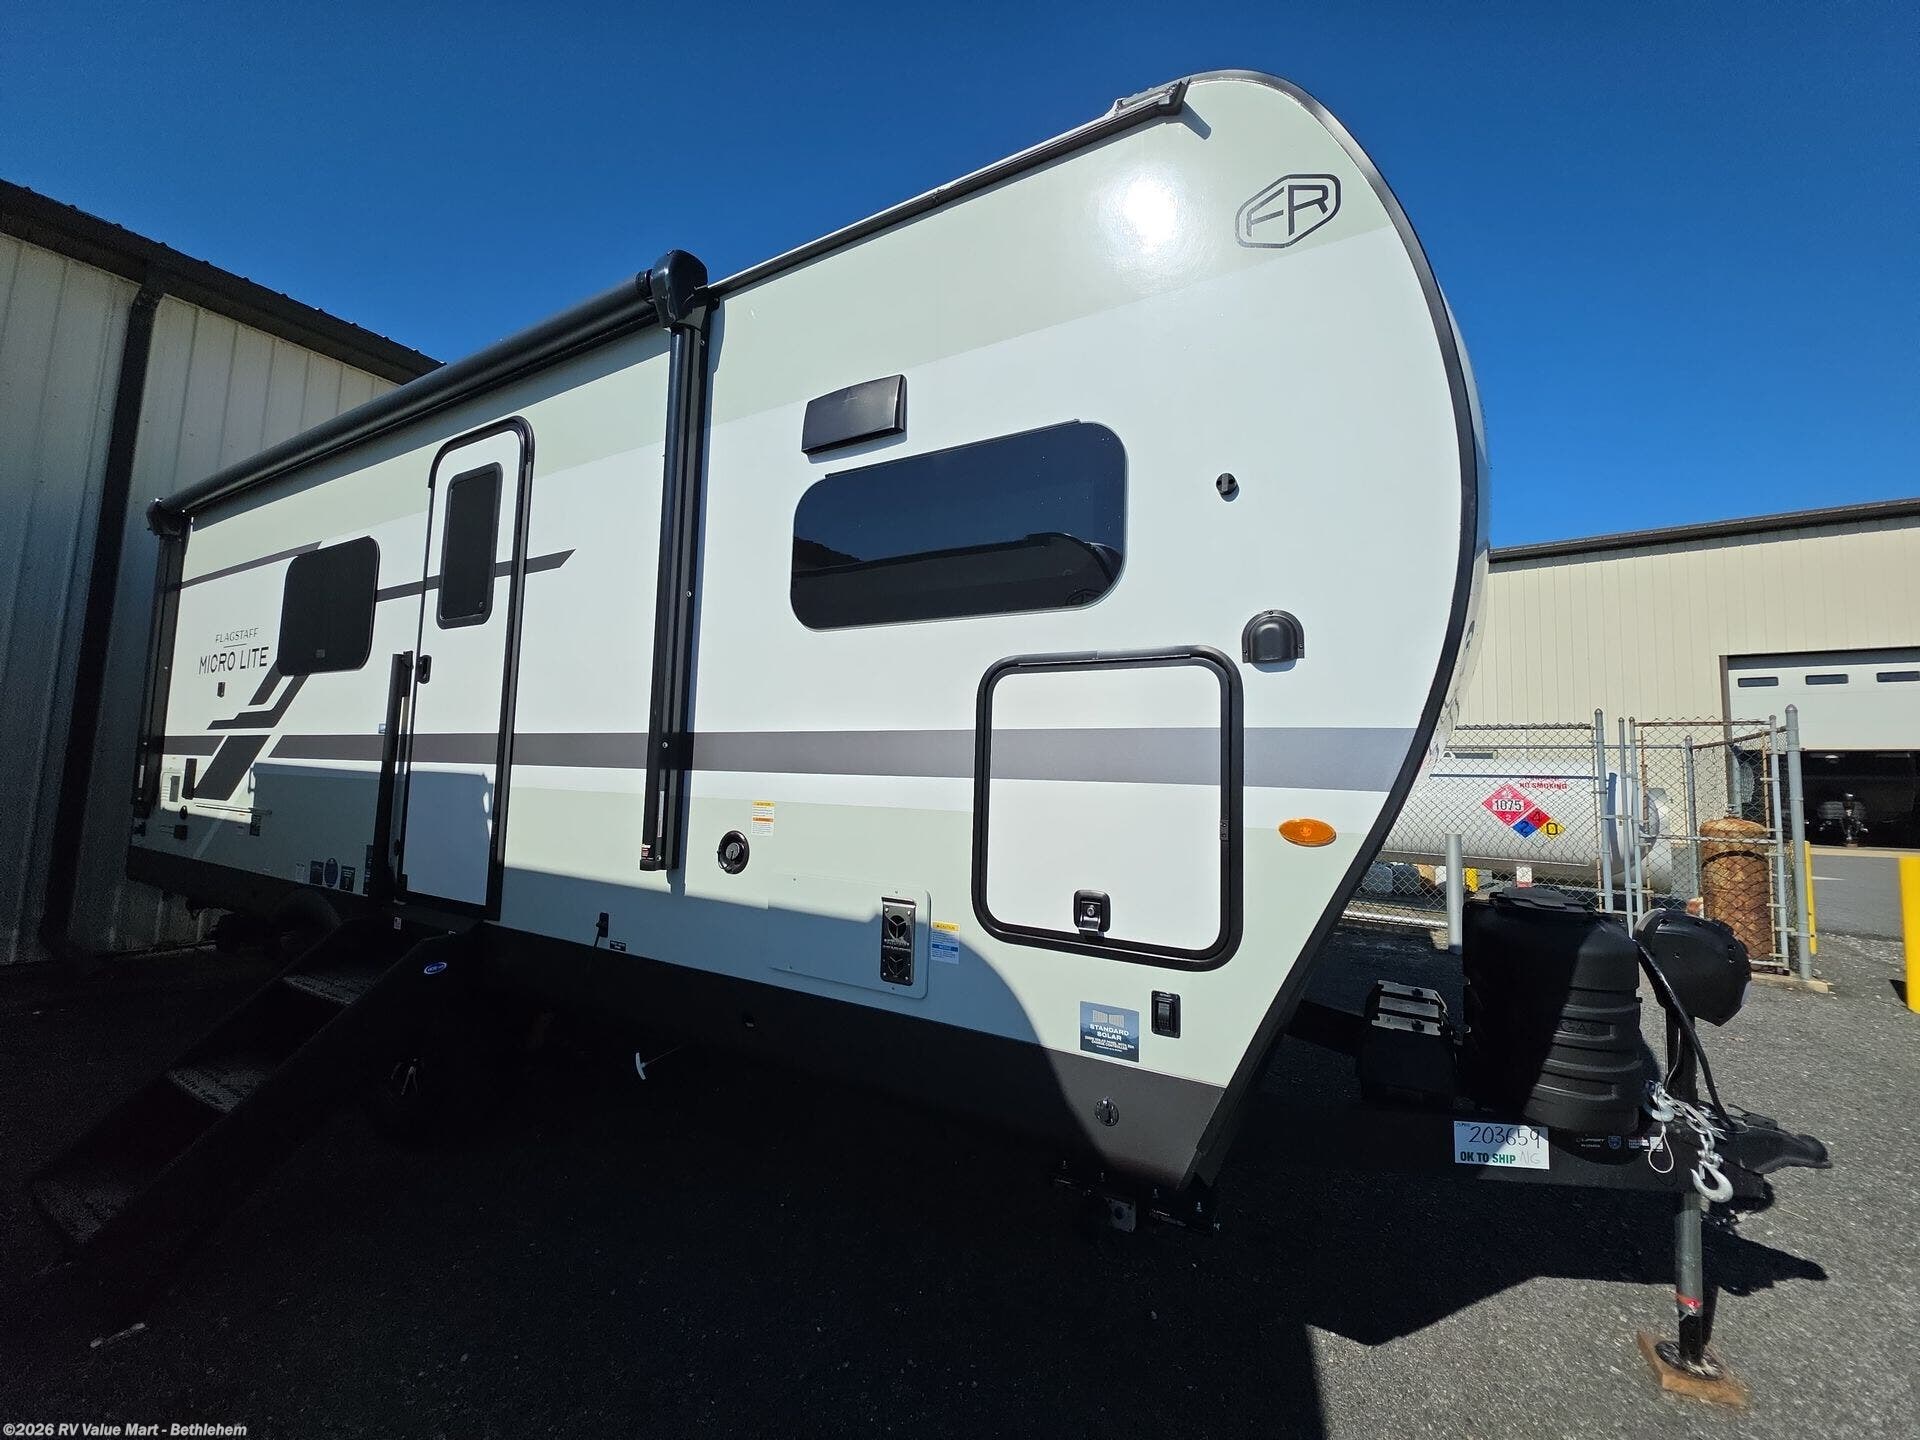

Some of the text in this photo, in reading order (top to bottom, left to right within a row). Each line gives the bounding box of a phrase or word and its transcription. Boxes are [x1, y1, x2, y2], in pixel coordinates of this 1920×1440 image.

[1246, 184, 1329, 237] FR
[215, 627, 259, 643] FLAGSTAFF
[199, 646, 269, 675] MICRO LITE
[1532, 782, 1568, 790] SMOKING
[1494, 799, 1522, 811] 1075
[1546, 822, 1558, 836] 0
[1089, 1023, 1130, 1037] STANDARD
[1096, 1031, 1122, 1042] SOLAR
[1468, 1125, 1540, 1149] 203659
[1460, 1151, 1516, 1164] OK TO SHIP
